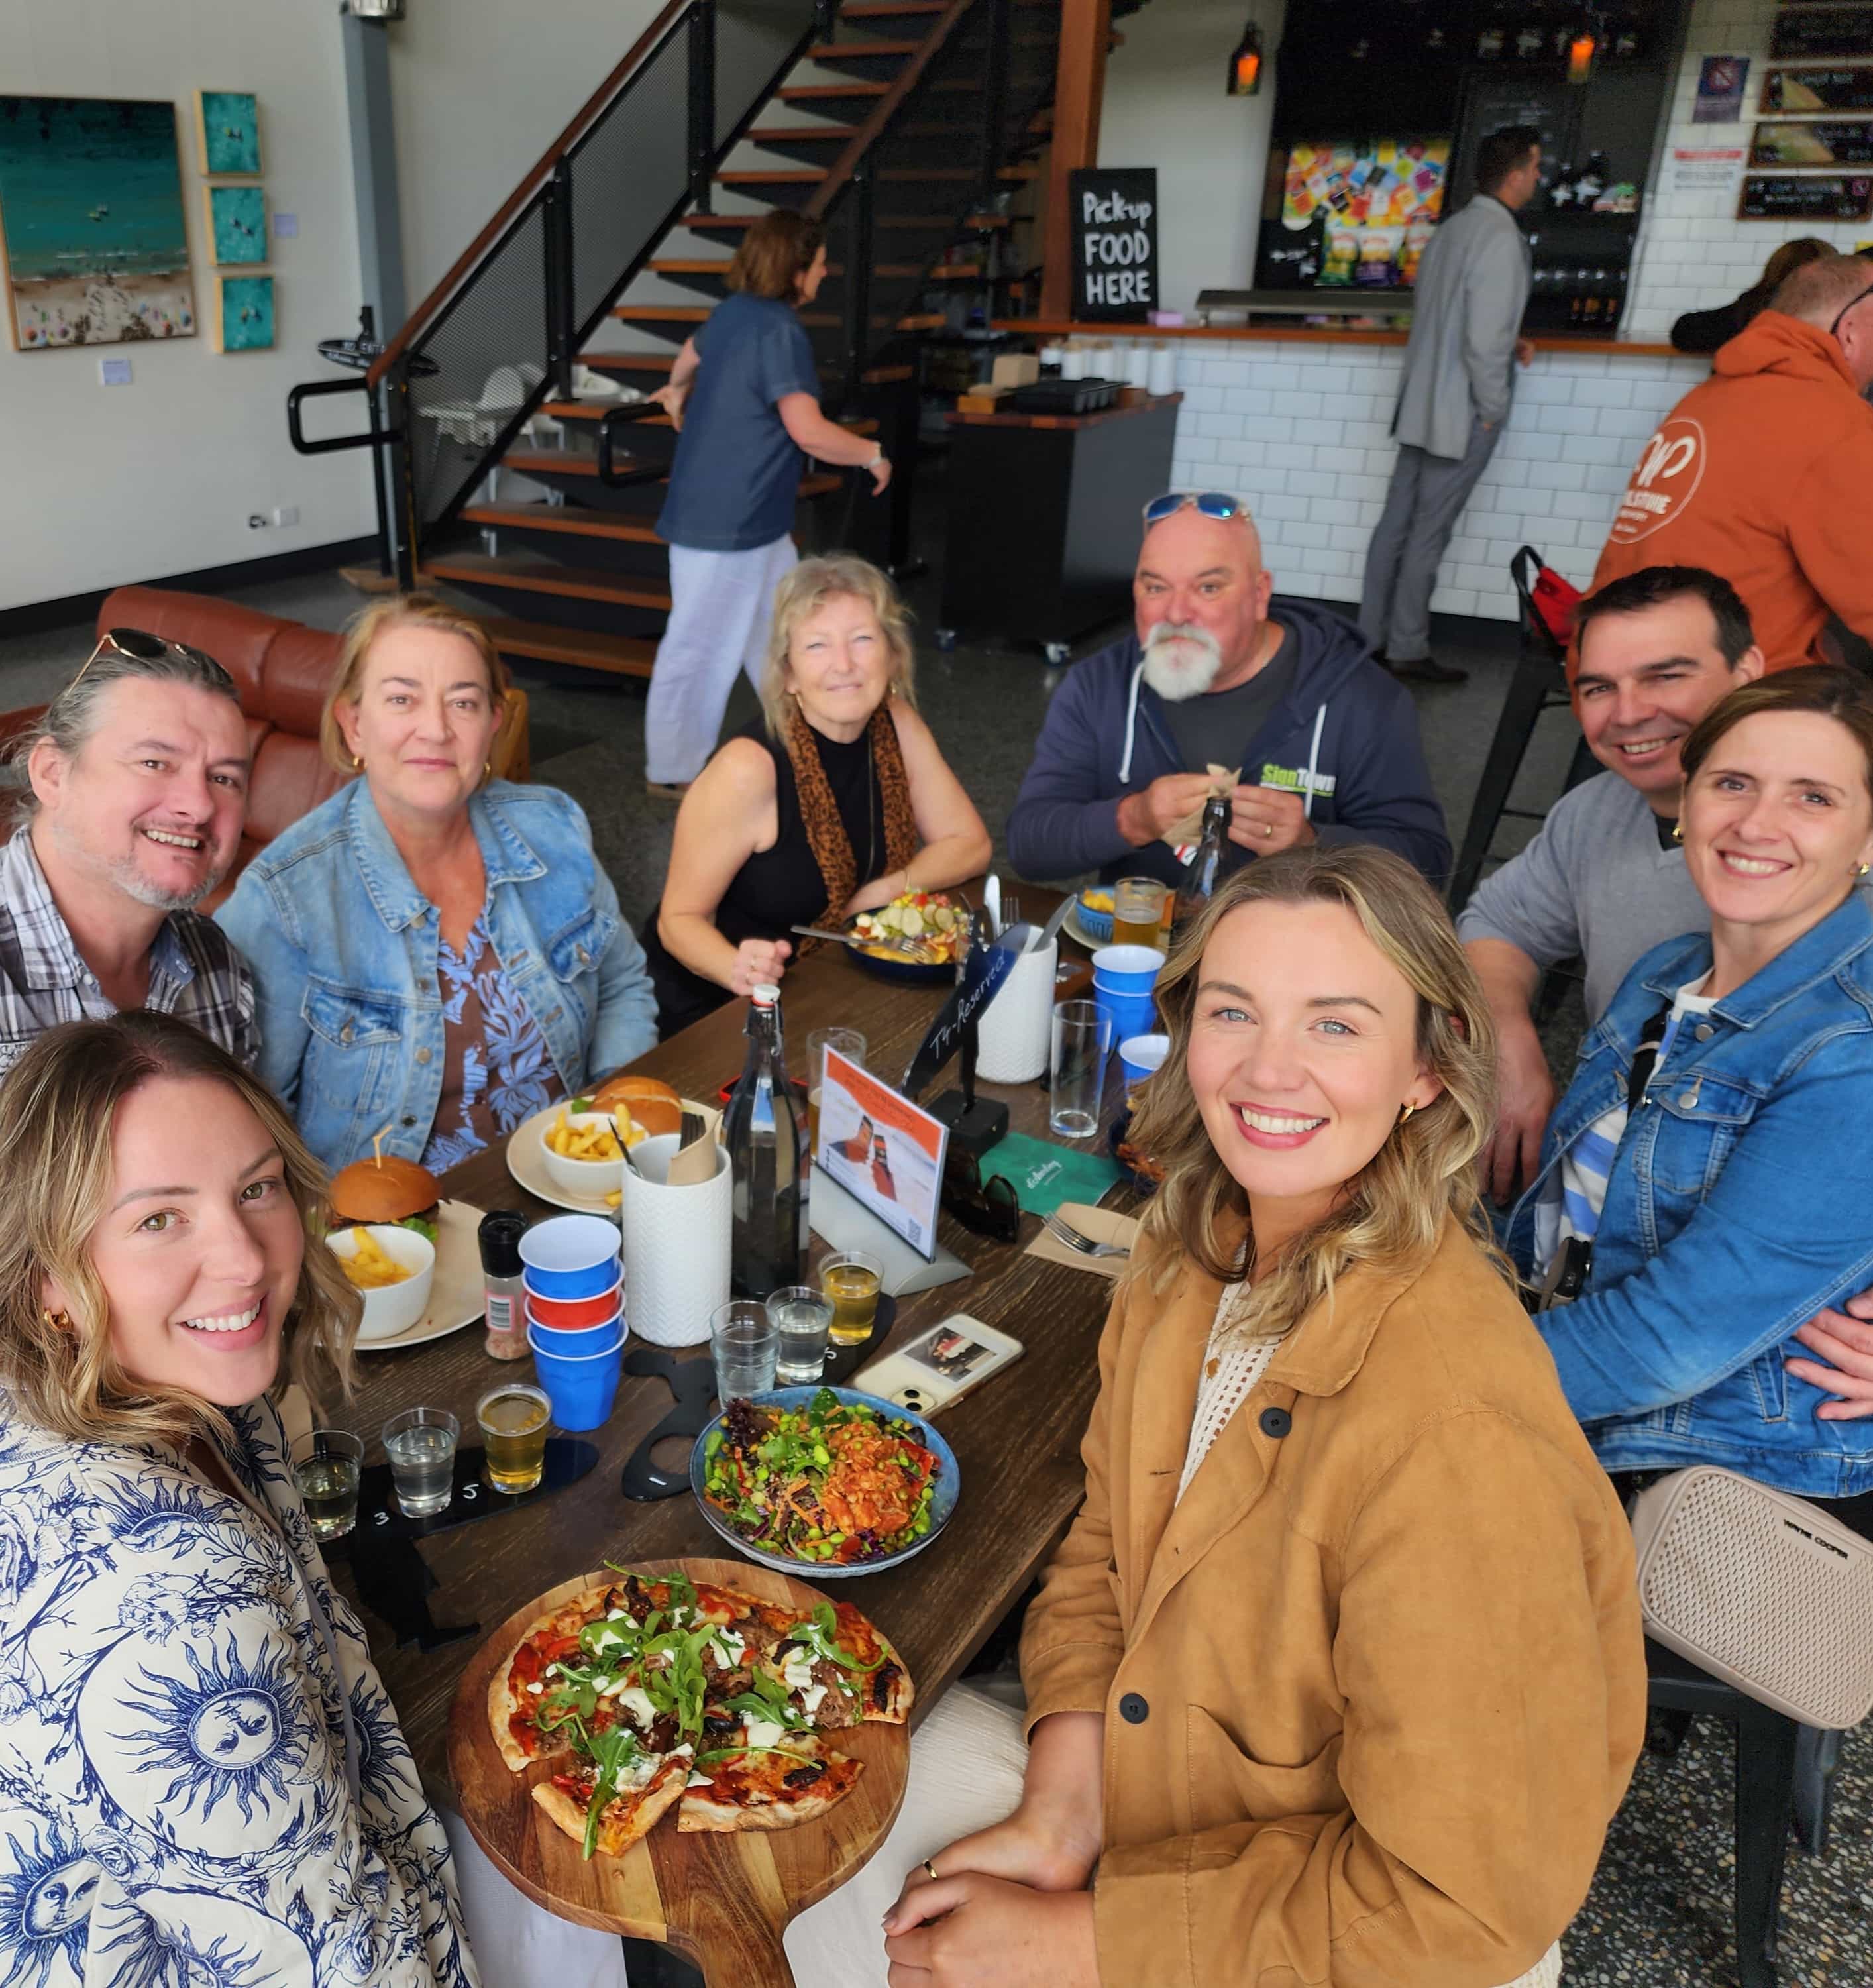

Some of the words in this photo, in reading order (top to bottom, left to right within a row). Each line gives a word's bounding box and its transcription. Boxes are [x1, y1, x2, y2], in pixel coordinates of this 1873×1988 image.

[1083, 190, 1153, 229] Pick-up
[1084, 229, 1151, 267] FOOD
[1085, 270, 1152, 305] HERE
[462, 1484, 480, 1500] 5
[373, 1512, 390, 1525] 3
[1814, 1537, 1849, 1560] COOPER
